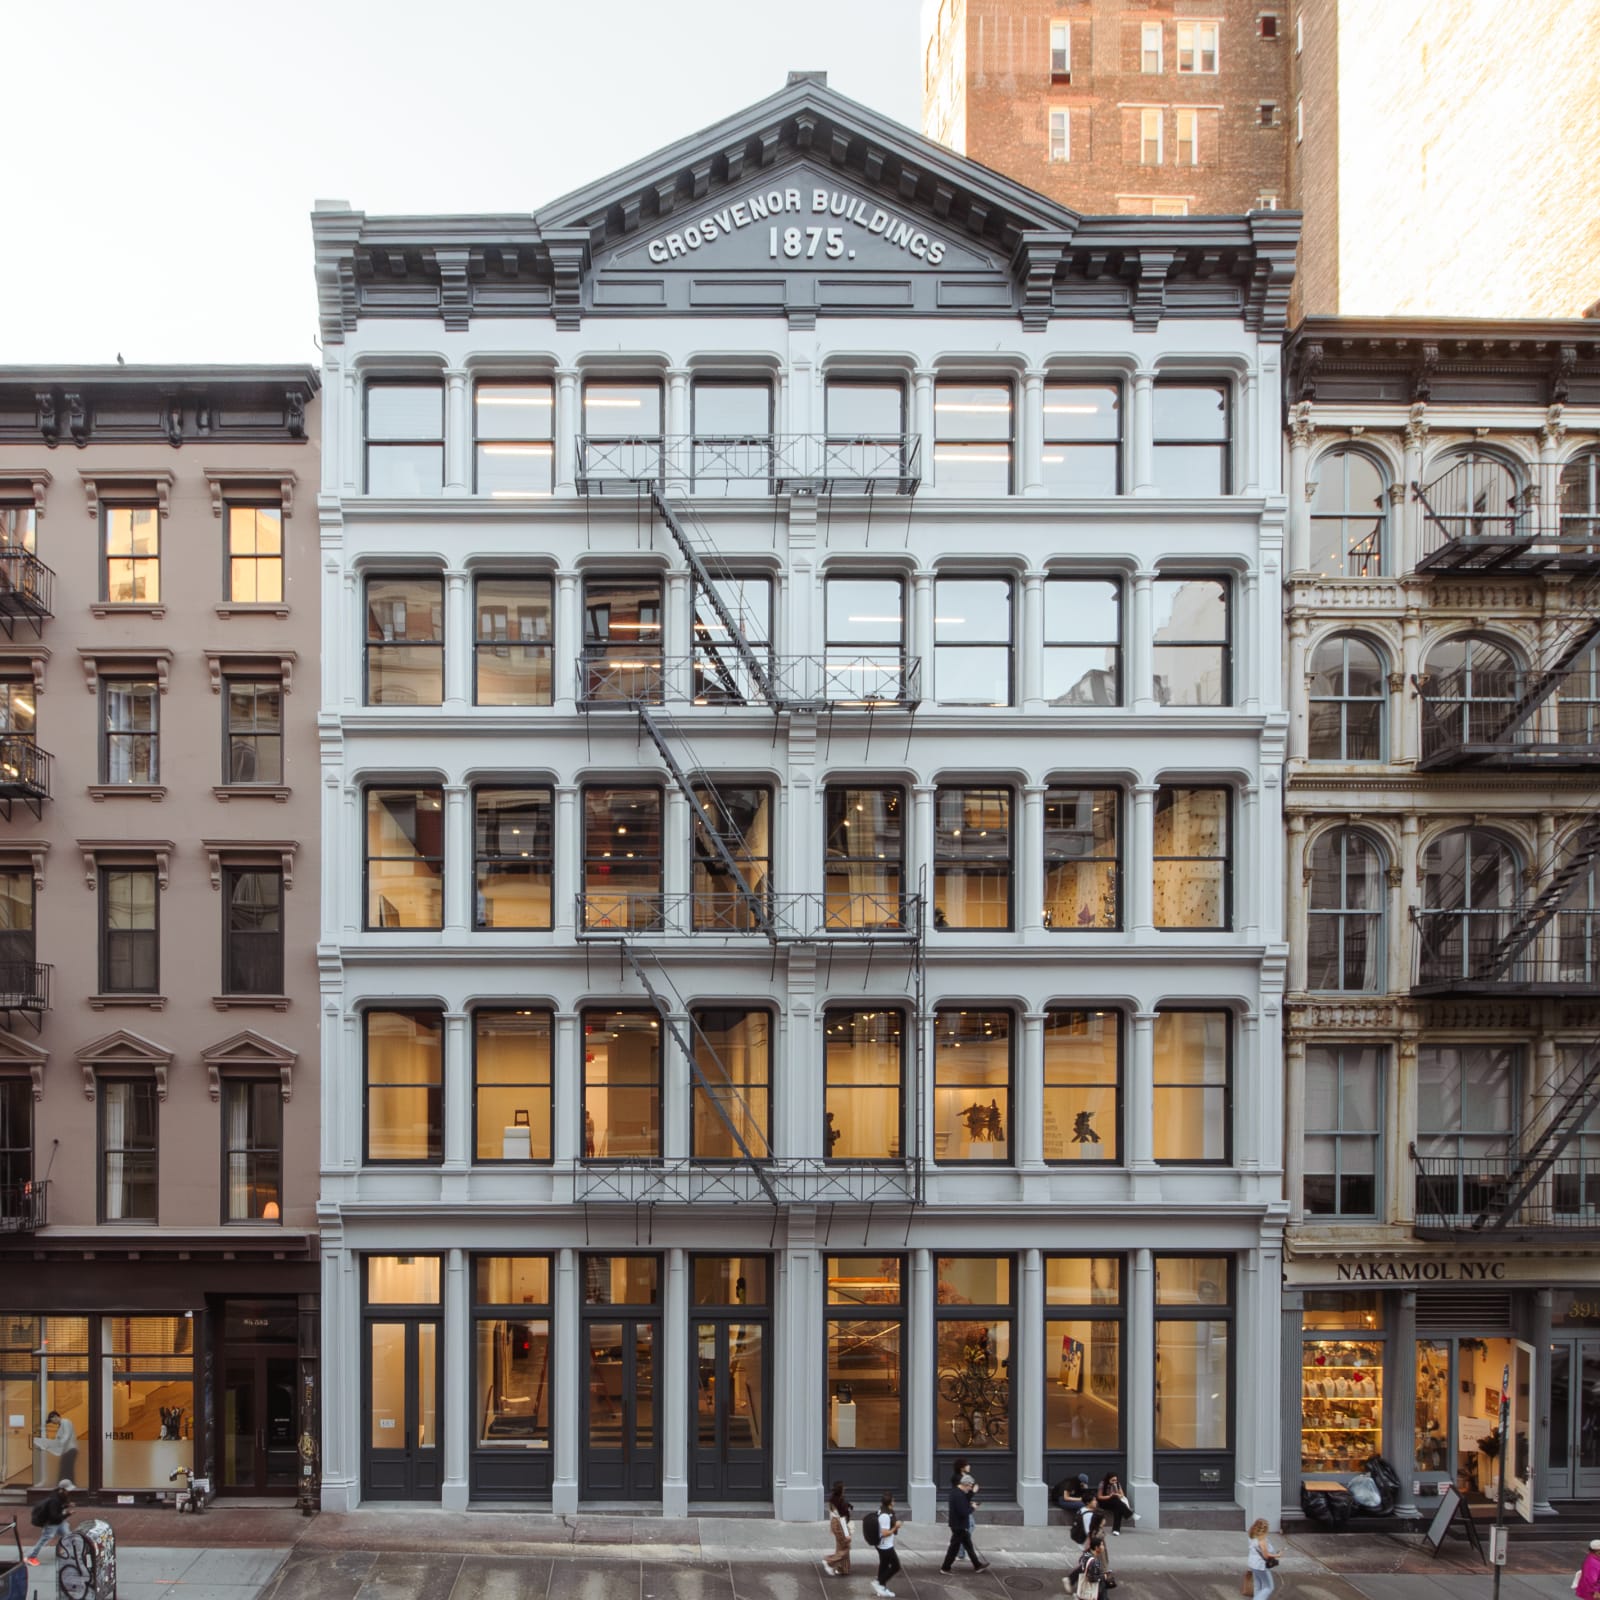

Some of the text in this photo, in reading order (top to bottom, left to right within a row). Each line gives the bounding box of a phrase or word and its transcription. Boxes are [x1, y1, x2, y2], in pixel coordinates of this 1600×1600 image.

[648, 188, 946, 265] GROSVENOR BUILDINGS
[769, 226, 855, 258] 1875.
[1336, 1262, 1505, 1281] NAKAMOL NYC
